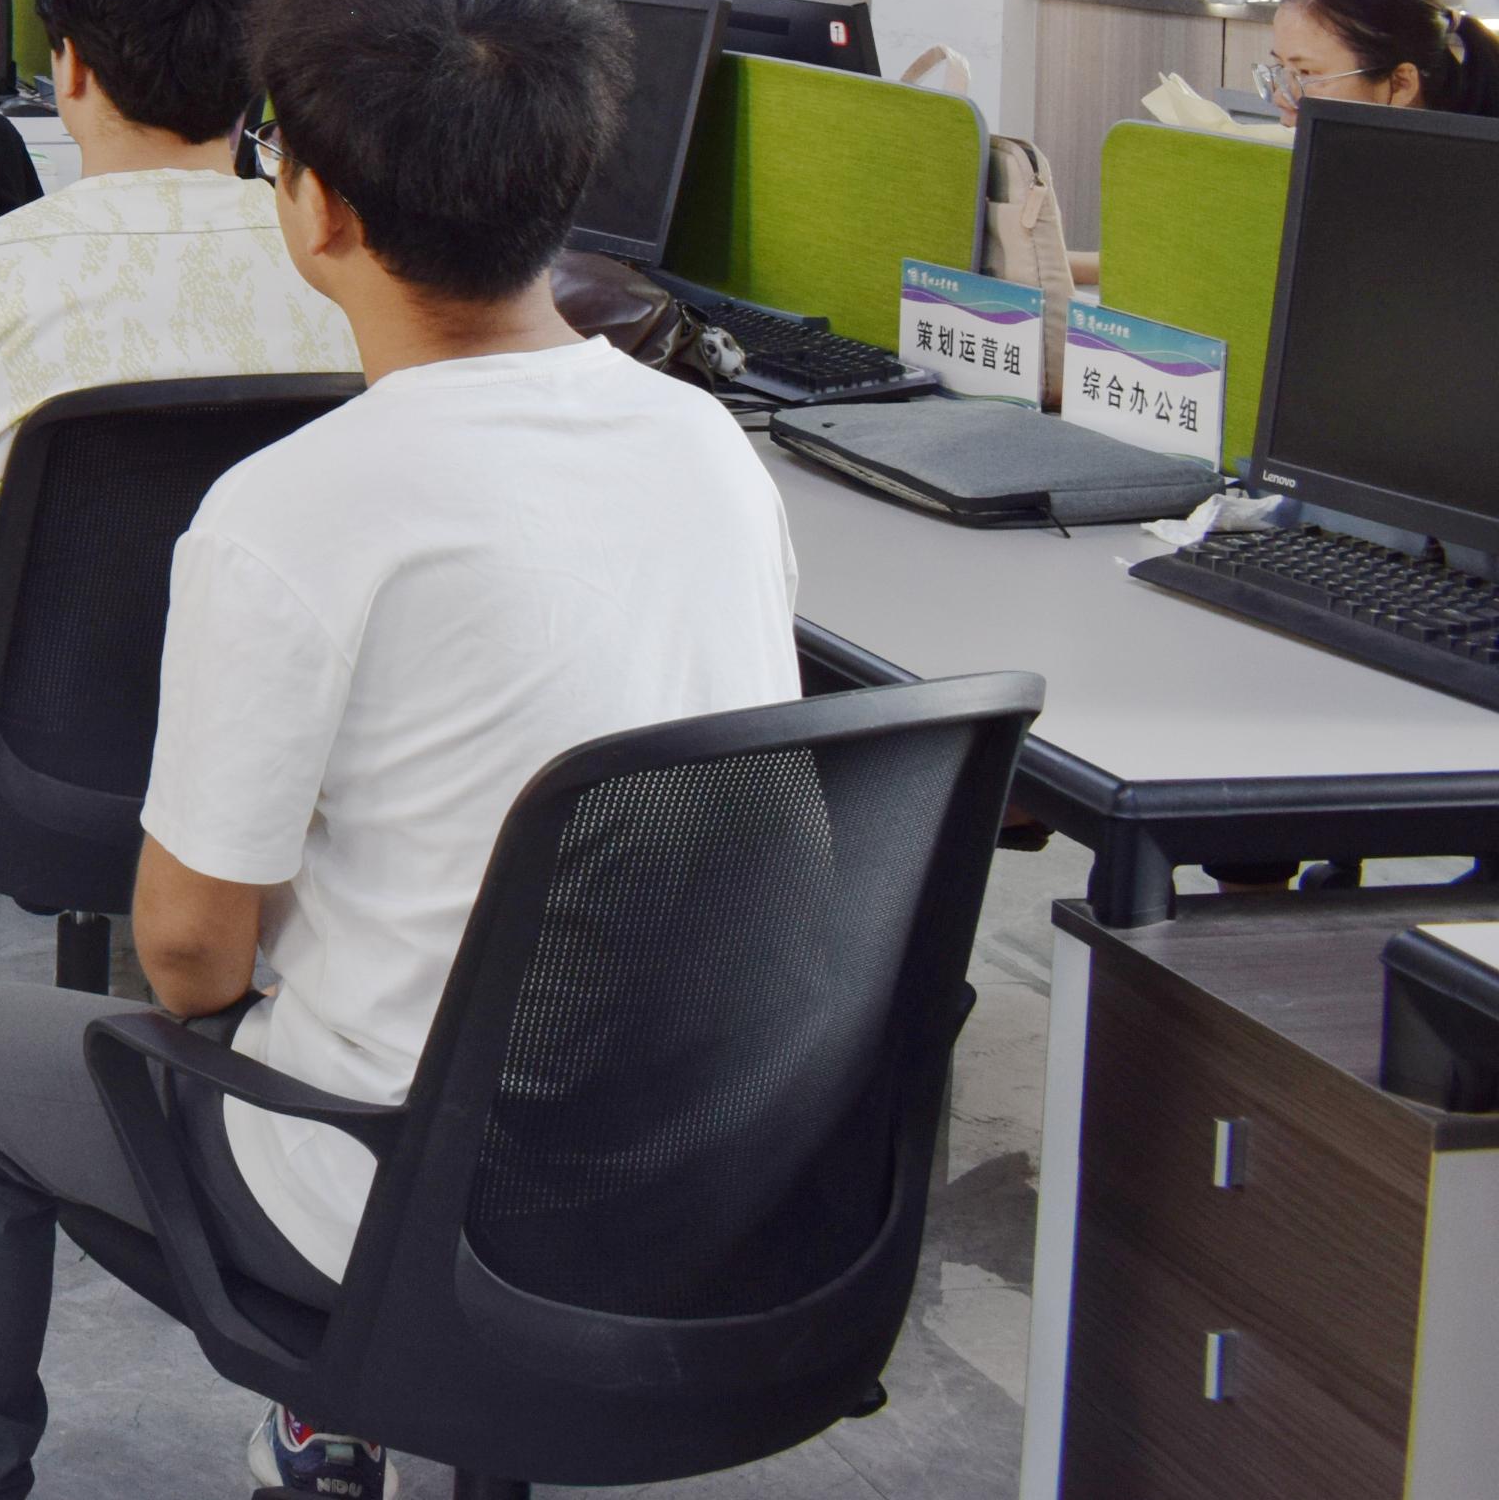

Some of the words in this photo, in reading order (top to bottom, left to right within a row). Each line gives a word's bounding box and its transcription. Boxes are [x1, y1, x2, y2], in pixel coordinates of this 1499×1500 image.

[916, 319, 1021, 376] 策划运营组
[1082, 367, 1199, 432] 综合办公组
[1263, 469, 1297, 488] Lenovo
